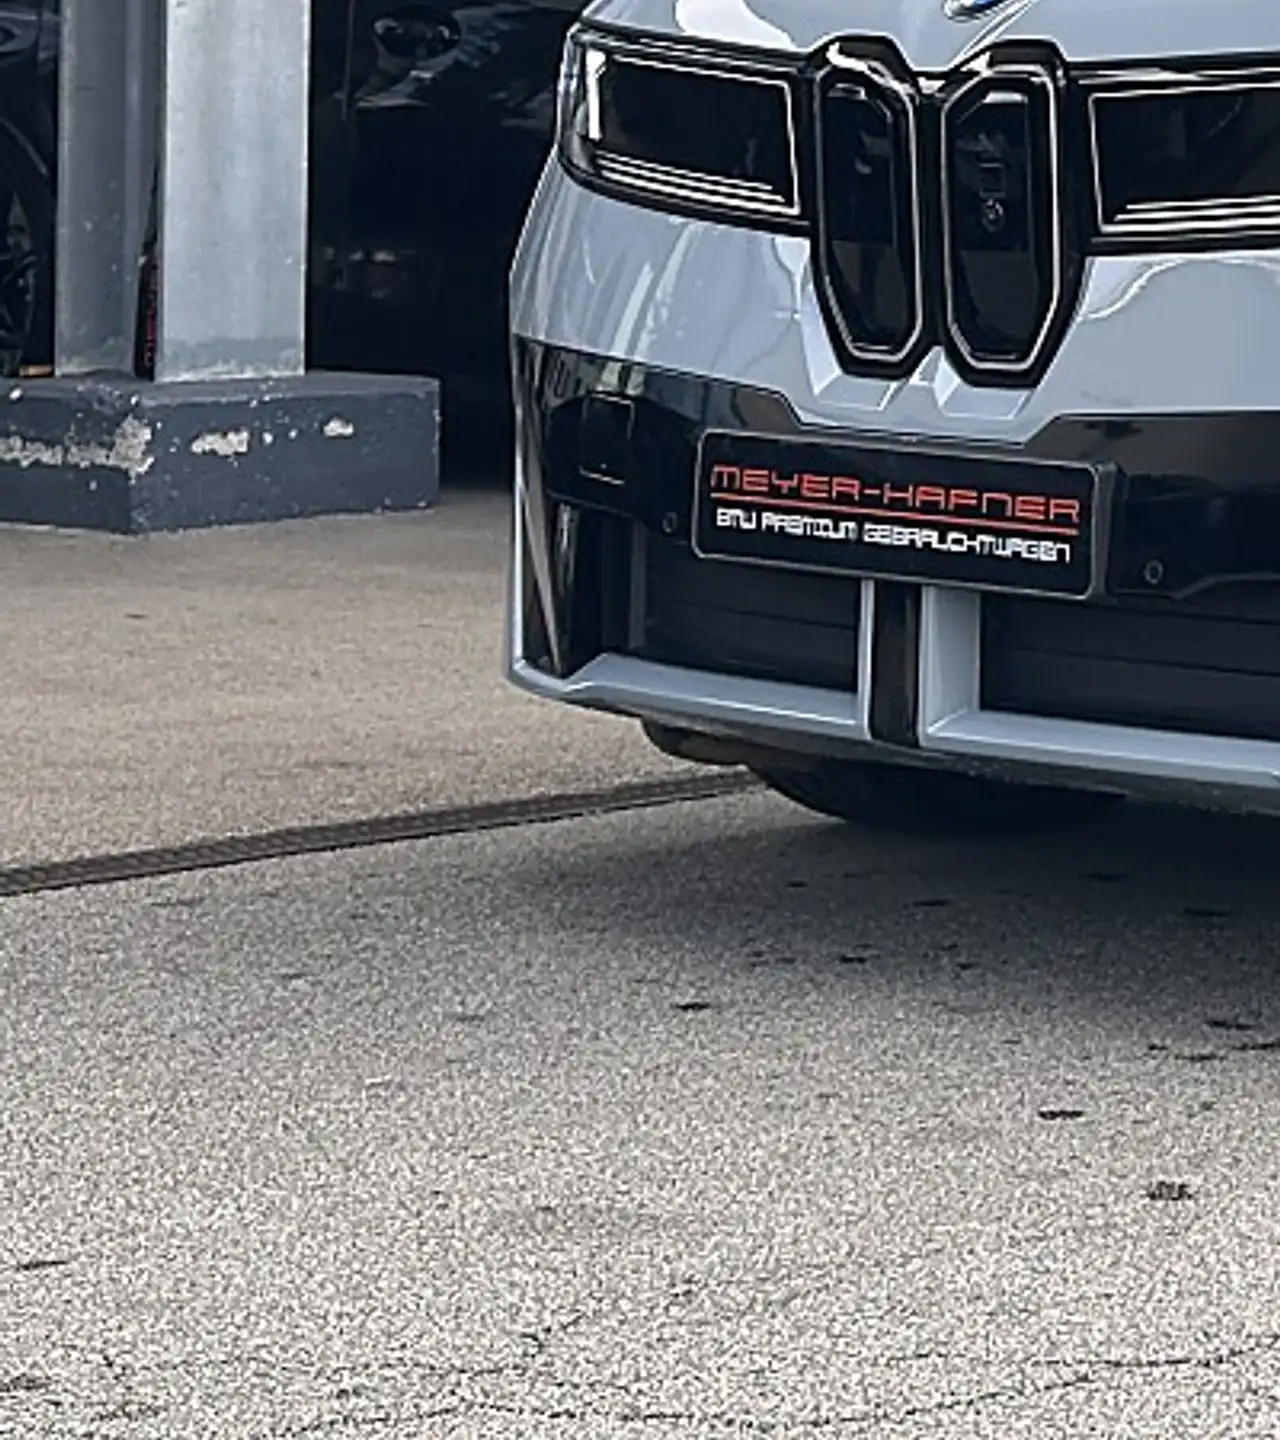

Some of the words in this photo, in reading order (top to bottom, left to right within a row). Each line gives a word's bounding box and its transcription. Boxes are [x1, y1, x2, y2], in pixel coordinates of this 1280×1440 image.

[710, 464, 1080, 523] MEYER-HAFNER
[716, 507, 757, 530] BMW
[761, 511, 858, 540] PREMIUM
[863, 521, 1070, 564] GEBRAUCHTWAGEN
